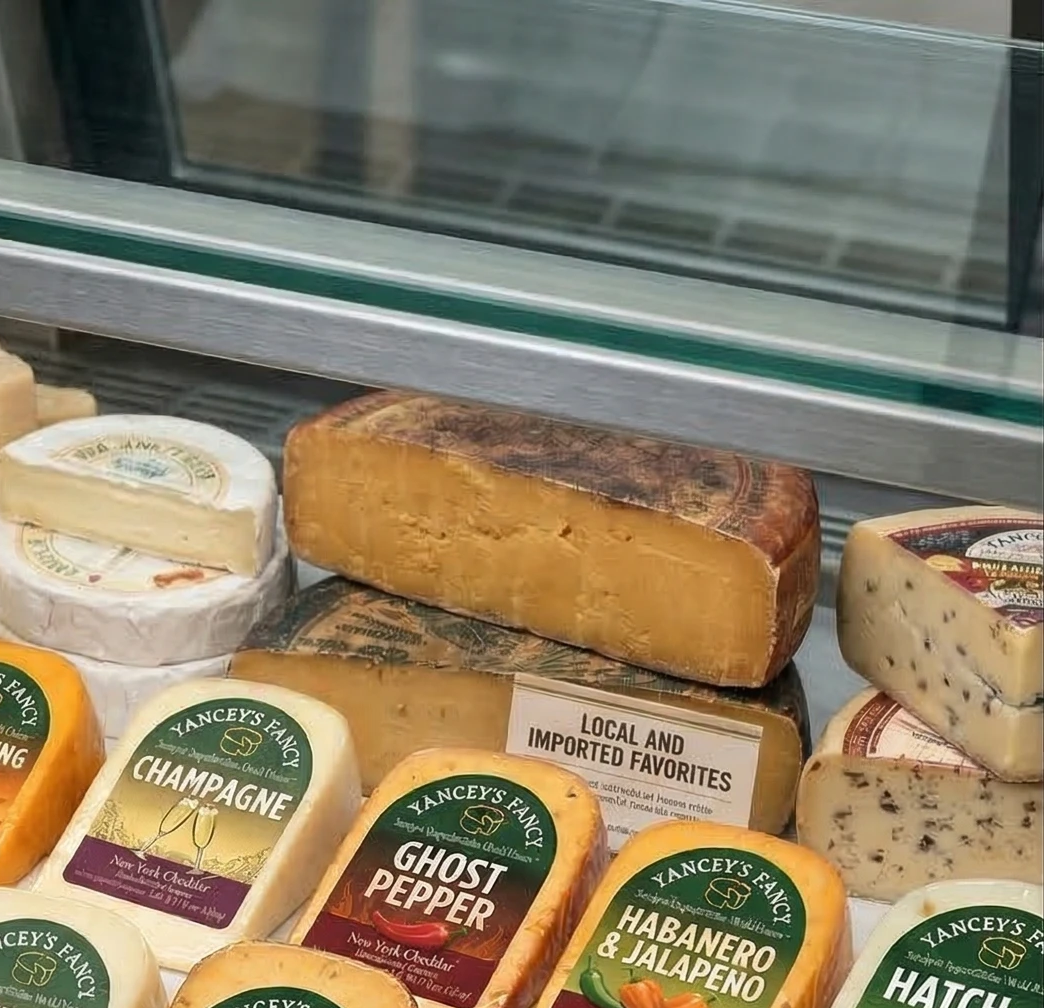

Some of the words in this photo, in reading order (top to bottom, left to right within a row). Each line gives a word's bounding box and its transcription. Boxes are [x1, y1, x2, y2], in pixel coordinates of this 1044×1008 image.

[170, 708, 265, 738] YANCEY'S
[581, 713, 638, 746] LOCAL
[644, 730, 684, 756] AND
[528, 727, 624, 766] IMPORTED
[630, 750, 732, 792] FAVORITES
[132, 755, 293, 820] CHAMPAGNE
[407, 785, 506, 816] YANCEY'S
[504, 797, 543, 849] FANCY
[393, 841, 508, 894] GHOST
[651, 858, 752, 889] YANCEY'S
[364, 868, 495, 931] PEPPER
[597, 932, 617, 959] &
[616, 905, 775, 972] HABANERO
[921, 918, 1026, 948] YANCEY'S
[57, 944, 97, 1000] FANCY
